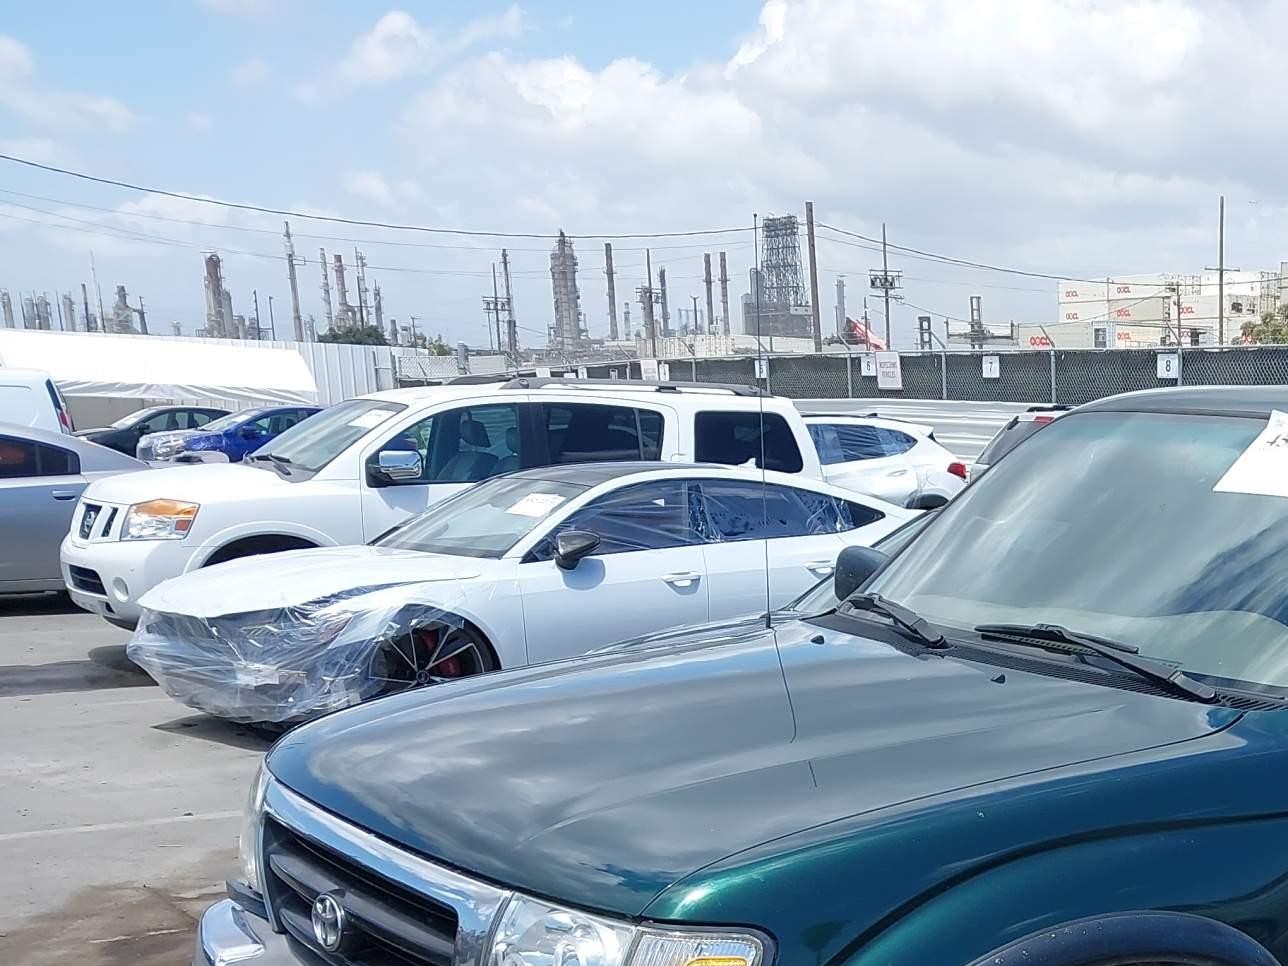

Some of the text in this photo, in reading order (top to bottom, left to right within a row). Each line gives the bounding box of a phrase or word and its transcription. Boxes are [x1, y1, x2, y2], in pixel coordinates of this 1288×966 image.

[866, 360, 871, 372] 6
[988, 361, 994, 373] 7
[1165, 359, 1172, 372] 8
